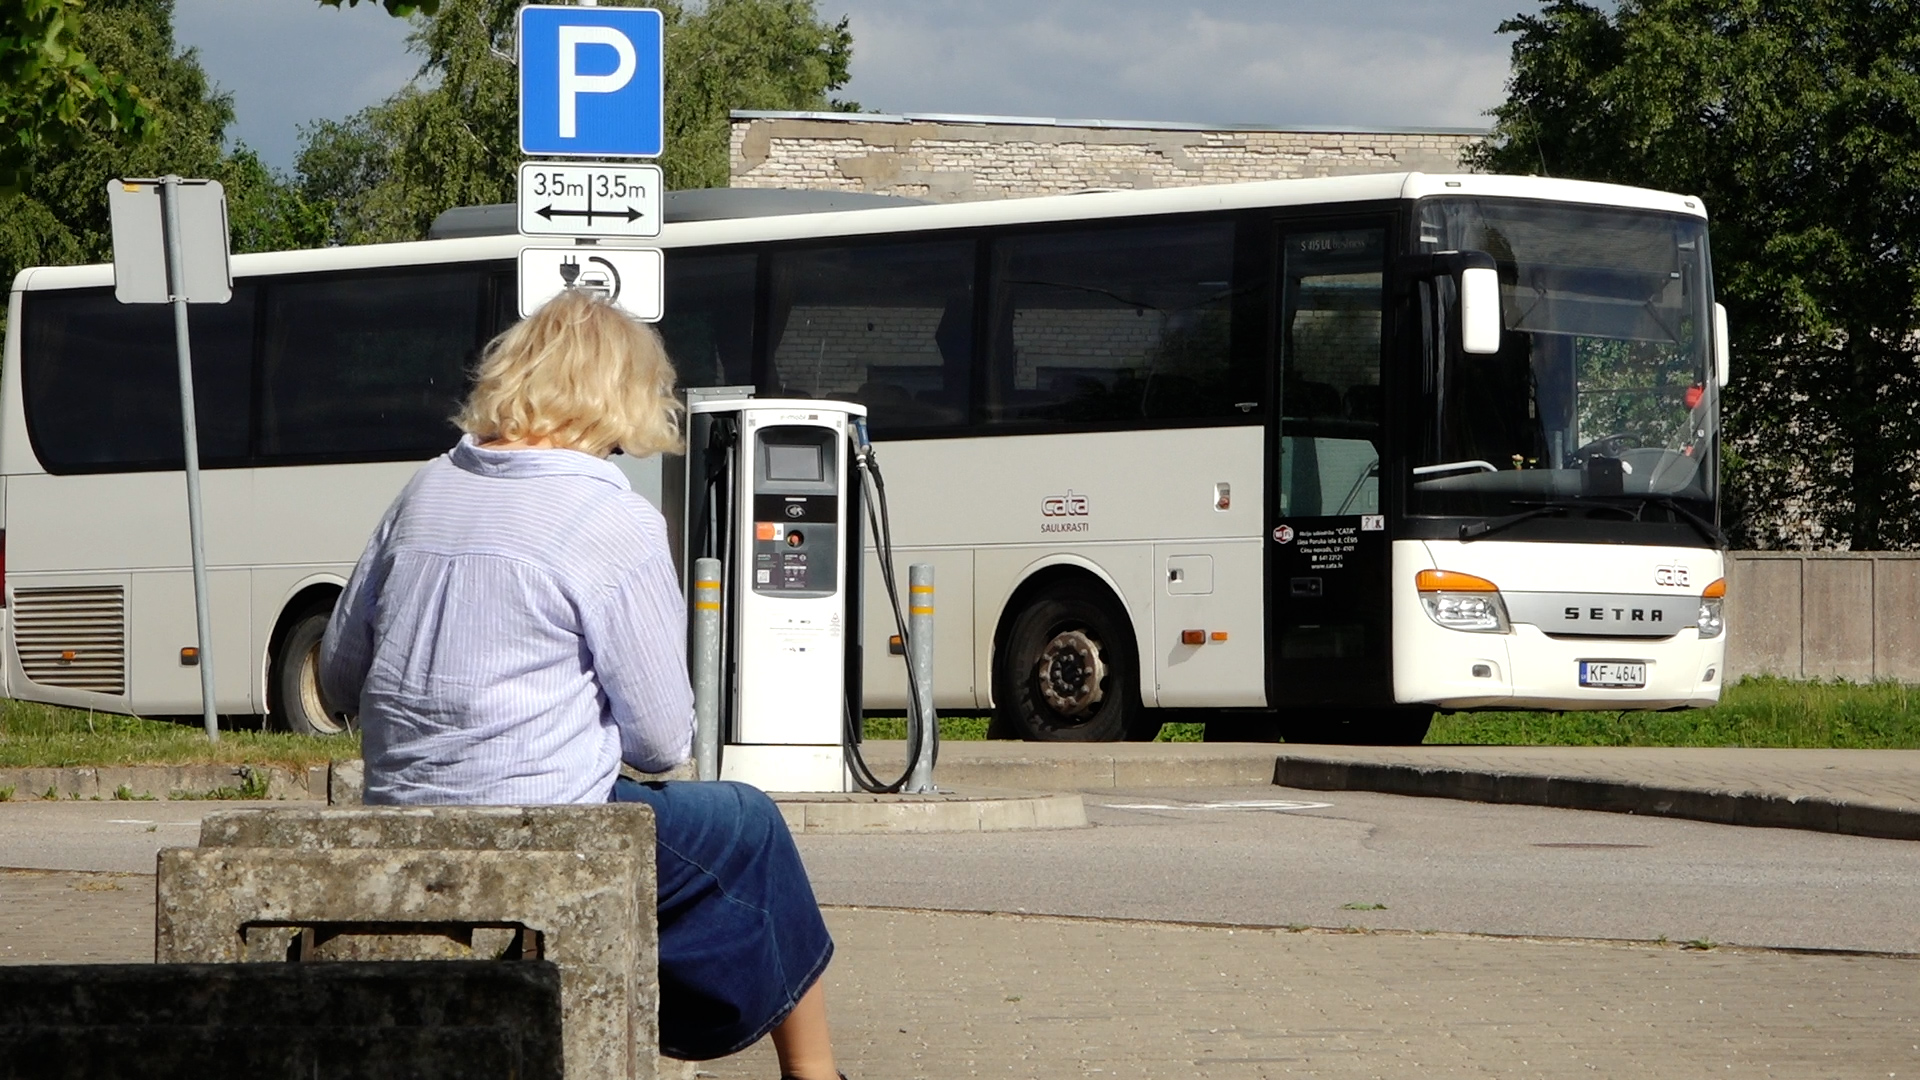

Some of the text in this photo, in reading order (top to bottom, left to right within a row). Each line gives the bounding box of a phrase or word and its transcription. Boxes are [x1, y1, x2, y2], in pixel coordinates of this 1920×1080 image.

[559, 25, 637, 138] P
[1041, 488, 1089, 517] cata
[1040, 522, 1089, 533] SAULKRASTI
[1654, 560, 1691, 588] cata
[1564, 607, 1663, 622] SETRA
[1589, 665, 1643, 682] KF-4641
